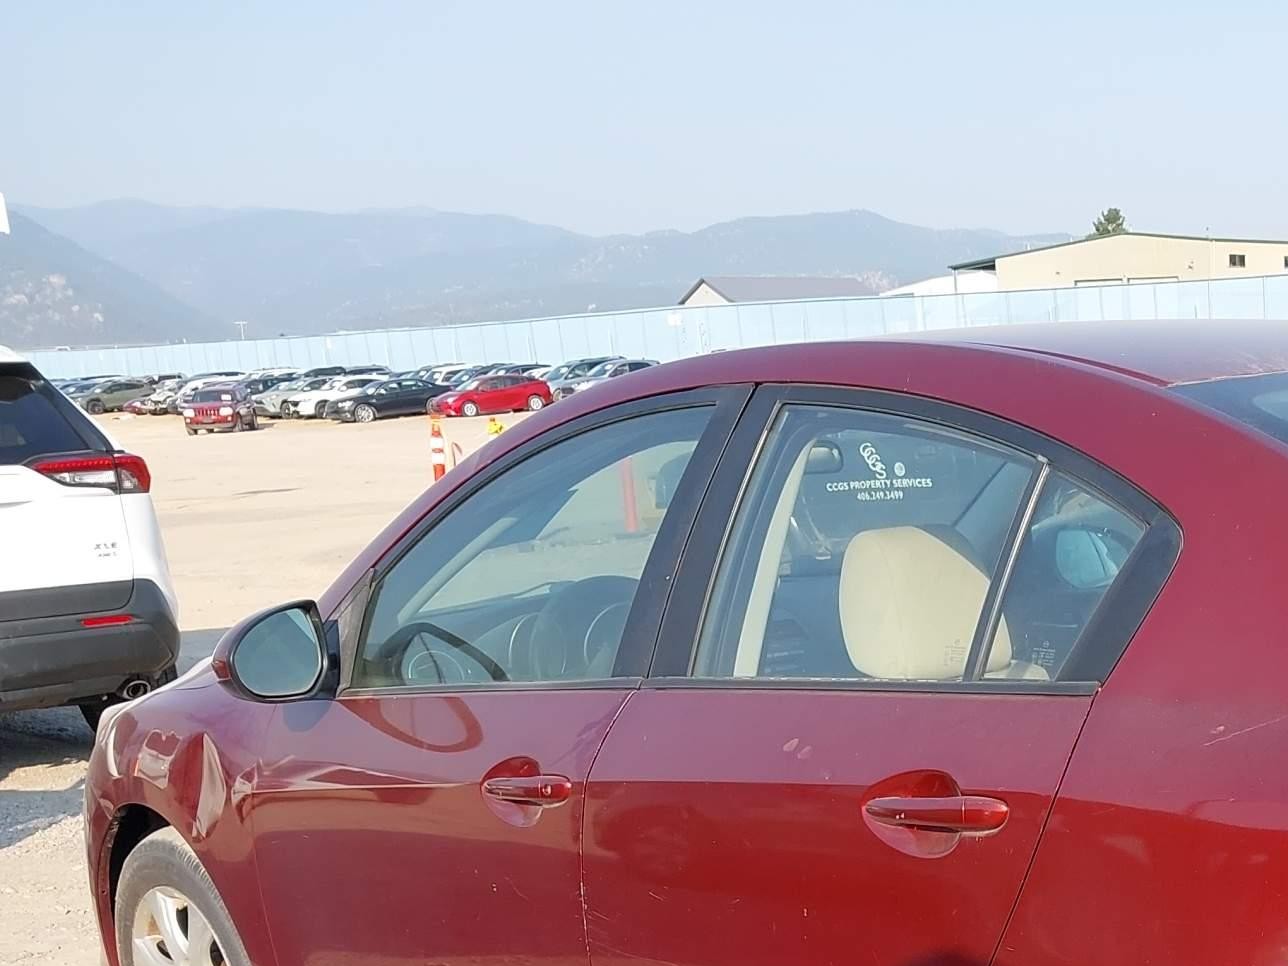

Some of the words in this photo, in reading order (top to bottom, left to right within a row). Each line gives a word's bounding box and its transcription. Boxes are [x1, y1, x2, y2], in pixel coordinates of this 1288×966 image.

[826, 483, 849, 492] CCGS
[850, 480, 891, 489] PROPERTY
[892, 478, 933, 488] SERVICES
